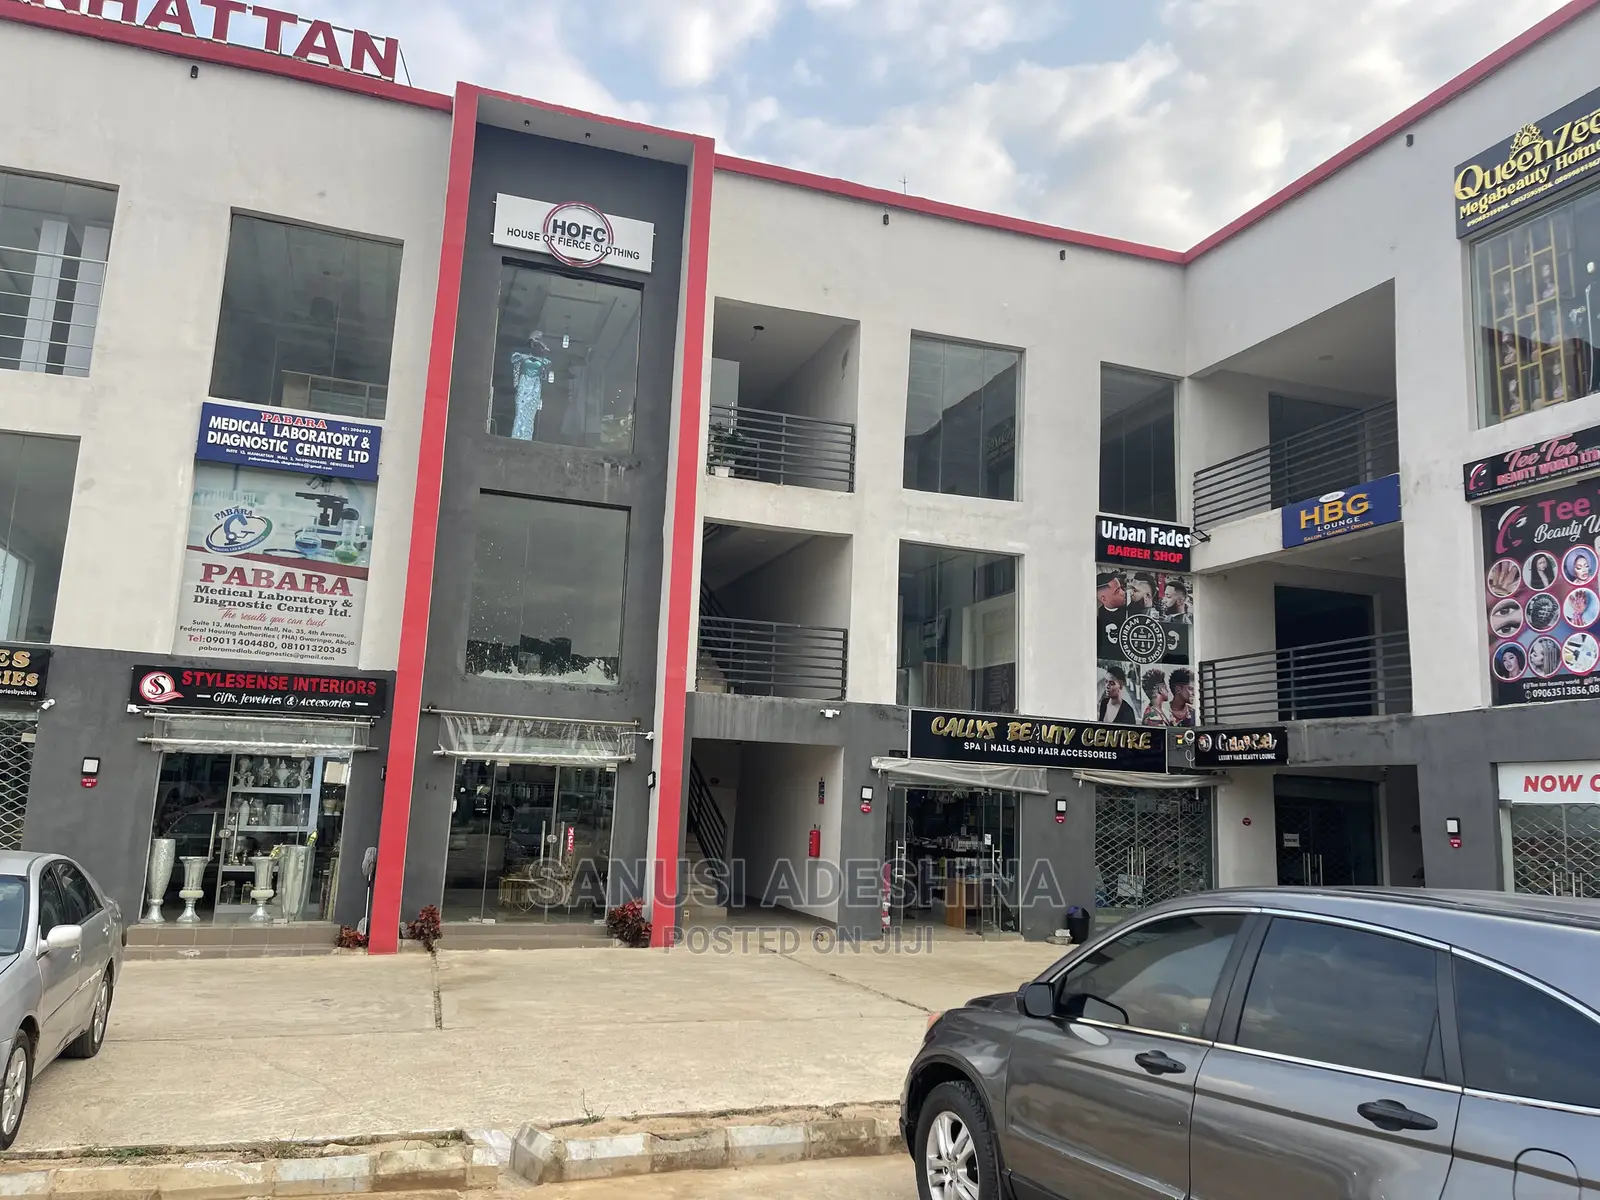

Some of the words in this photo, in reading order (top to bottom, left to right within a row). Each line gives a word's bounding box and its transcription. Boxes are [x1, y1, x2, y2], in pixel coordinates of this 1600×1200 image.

[1459, 164, 1552, 219] Megabeauty
[552, 218, 607, 243] HOFC
[506, 227, 540, 242] HOUSE
[542, 234, 555, 243] OF
[558, 237, 591, 251] FIERCE
[594, 242, 640, 260] CLOTHING
[260, 412, 328, 429] PABARA
[208, 416, 267, 436] MEDICAL
[273, 424, 359, 447] LABORATORY
[360, 437, 371, 449] &
[207, 431, 289, 453] DIAGNOSTIC
[295, 443, 343, 460] CENTRE
[348, 449, 370, 464] LTD
[1503, 444, 1540, 472] Tee
[1540, 433, 1578, 461] Tee
[1496, 465, 1537, 486] BEAUTY
[1538, 455, 1578, 475] WORLD
[213, 508, 253, 521] PABARA
[1300, 493, 1369, 529] HBG
[1537, 497, 1590, 523] Tee
[1101, 520, 1146, 543] Urban
[1150, 526, 1191, 548] Fades
[1317, 516, 1361, 531] LOUNGE
[1533, 519, 1582, 543] Beauty
[1107, 544, 1151, 560] BARBER
[1153, 550, 1183, 564] SHOP
[199, 563, 353, 597] PABARA
[193, 595, 272, 610] Diagnostic
[277, 602, 324, 615] Centre
[328, 607, 352, 618] ltd.
[195, 585, 253, 598] Medical
[257, 590, 337, 607] Laboratory
[342, 599, 353, 608] &
[192, 619, 210, 627] Suite
[224, 622, 262, 631] Manhattan
[263, 625, 280, 633] Mall,
[218, 606, 236, 620] The
[241, 611, 267, 623] results
[269, 616, 285, 626] you
[287, 617, 304, 625] can
[306, 617, 327, 627] trust
[179, 625, 207, 633] Federal
[208, 628, 237, 636] Housing
[238, 630, 275, 639] Authorities
[1122, 617, 1140, 641] URBAN
[1145, 618, 1163, 643] FADES
[281, 642, 347, 655] 08101320345
[1123, 644, 1147, 664] BARBER
[0, 670, 39, 687] IES
[182, 670, 289, 690] STYLESENSE
[293, 676, 377, 696] INTERIORS
[213, 692, 238, 705] Gifts,
[239, 693, 282, 705] jewelries
[286, 695, 295, 706] &
[299, 697, 352, 708] Accessories
[931, 715, 998, 740] CALLYS
[1006, 721, 1077, 746] BEAUTY
[1081, 727, 1152, 750] CENTRE
[963, 742, 981, 750] SPA
[990, 744, 1016, 753] NAILS
[1017, 746, 1036, 754] AND
[1037, 747, 1059, 756] HAIR
[1060, 748, 1117, 760] ACCESSORIES
[1523, 774, 1584, 792] NOW
